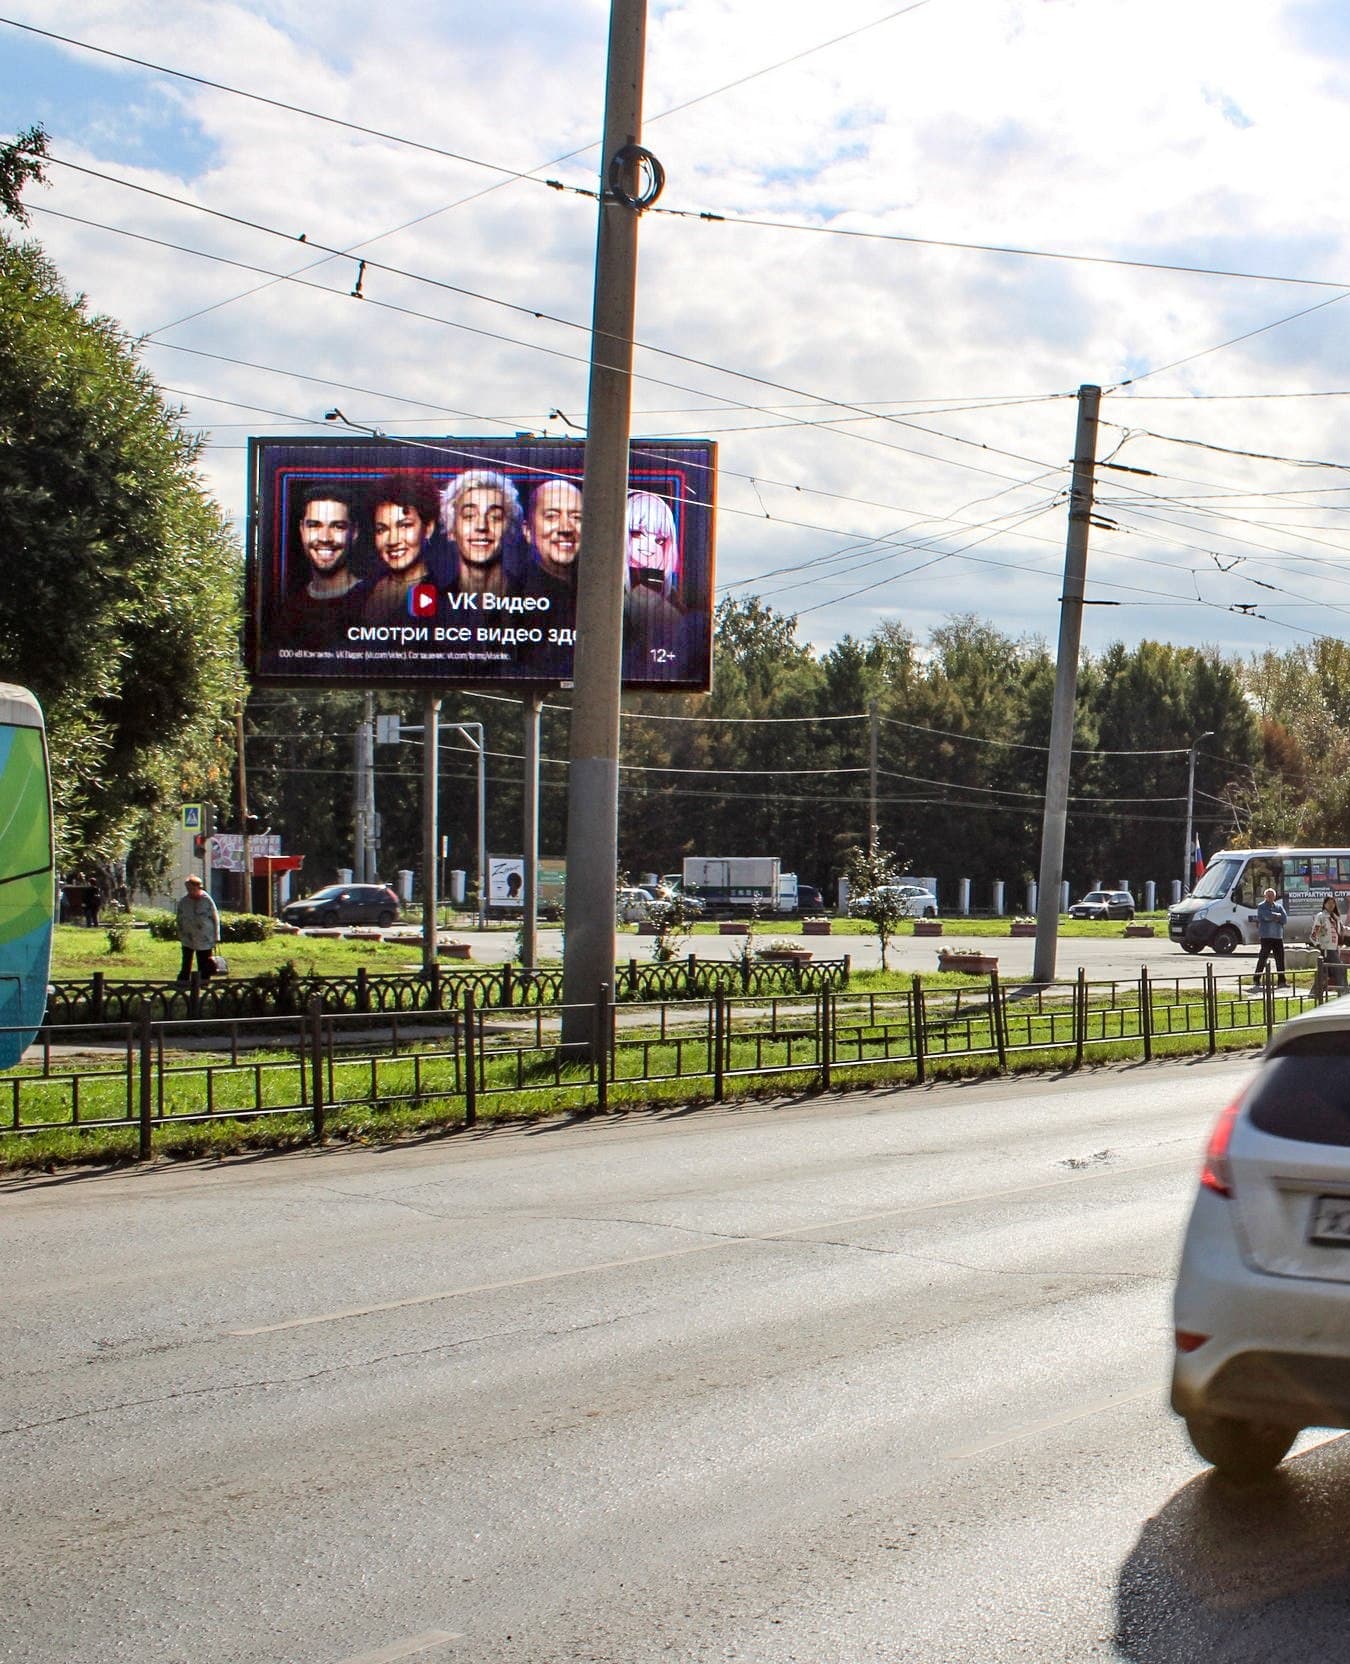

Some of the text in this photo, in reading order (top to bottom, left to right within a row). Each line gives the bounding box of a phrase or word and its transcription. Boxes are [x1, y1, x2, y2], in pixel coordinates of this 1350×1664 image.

[448, 592, 550, 614] VK Видео
[347, 626, 429, 645] смотри
[434, 626, 472, 642] все
[476, 626, 543, 646] видео
[650, 648, 676, 663] 12+
